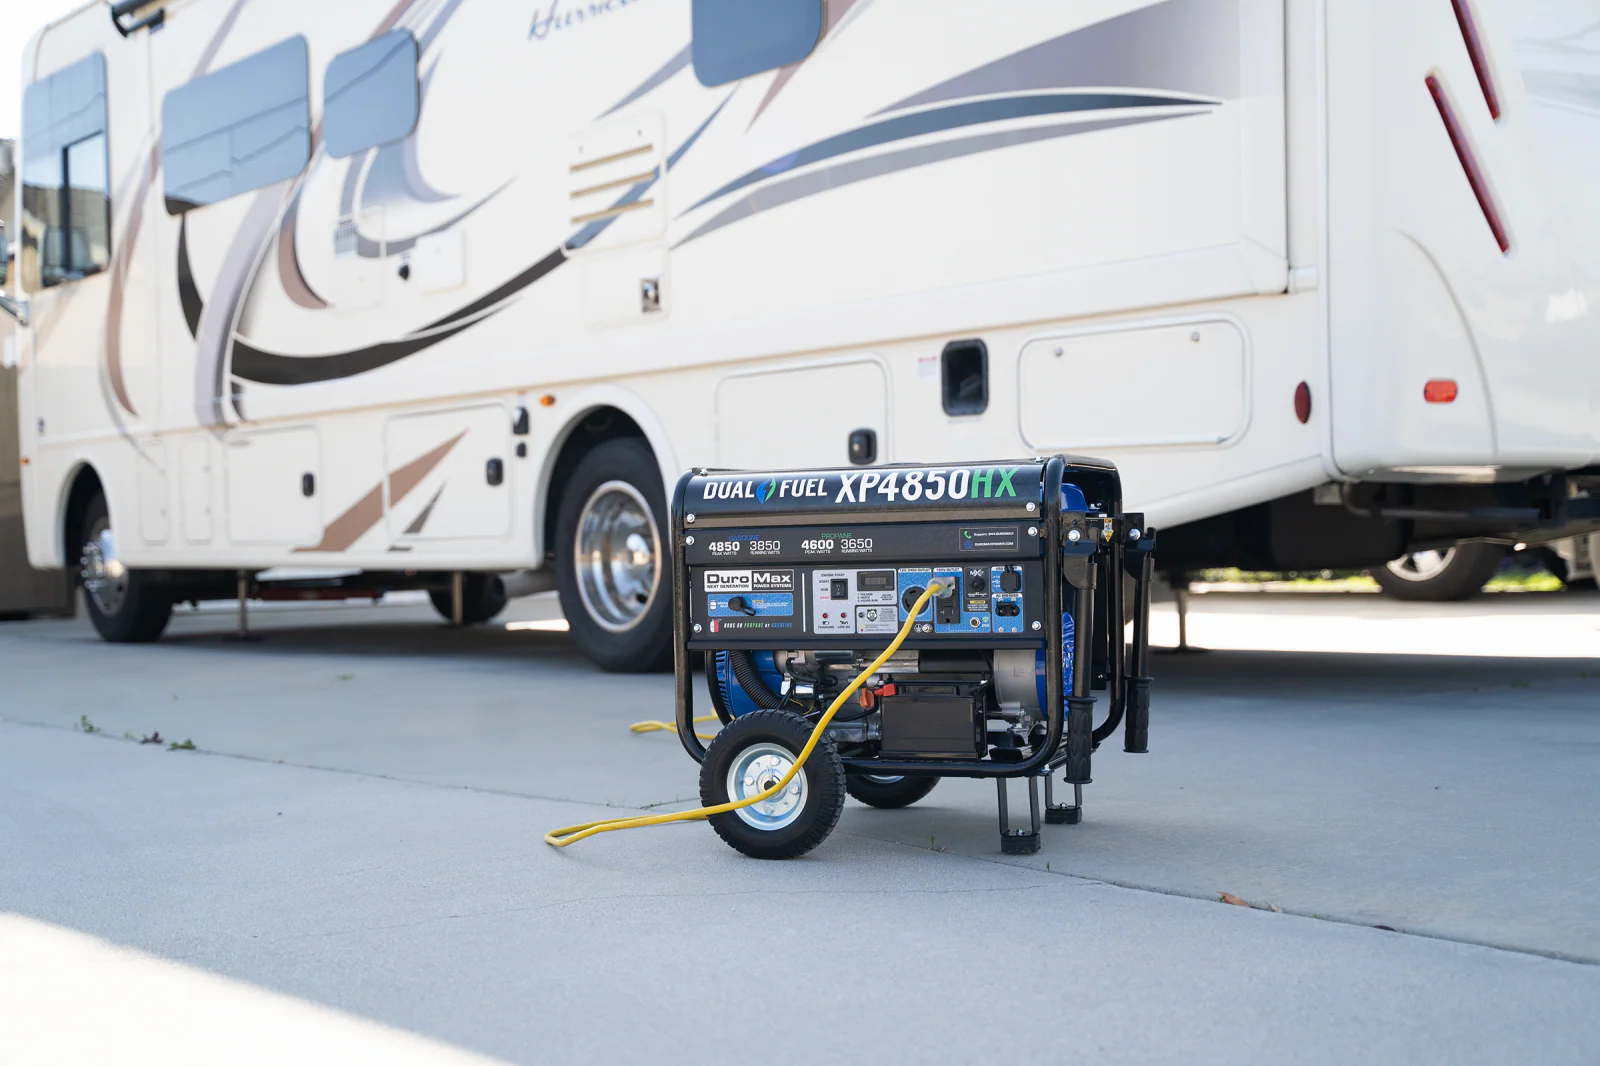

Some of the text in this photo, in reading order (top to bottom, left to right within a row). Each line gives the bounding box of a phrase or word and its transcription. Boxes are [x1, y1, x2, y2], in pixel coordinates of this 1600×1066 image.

[703, 467, 1021, 504] DUAL FUEL XP4850HX
[821, 532, 853, 540] PROPANE
[708, 540, 781, 552] 4850 3850
[801, 538, 873, 550] 4600 3650
